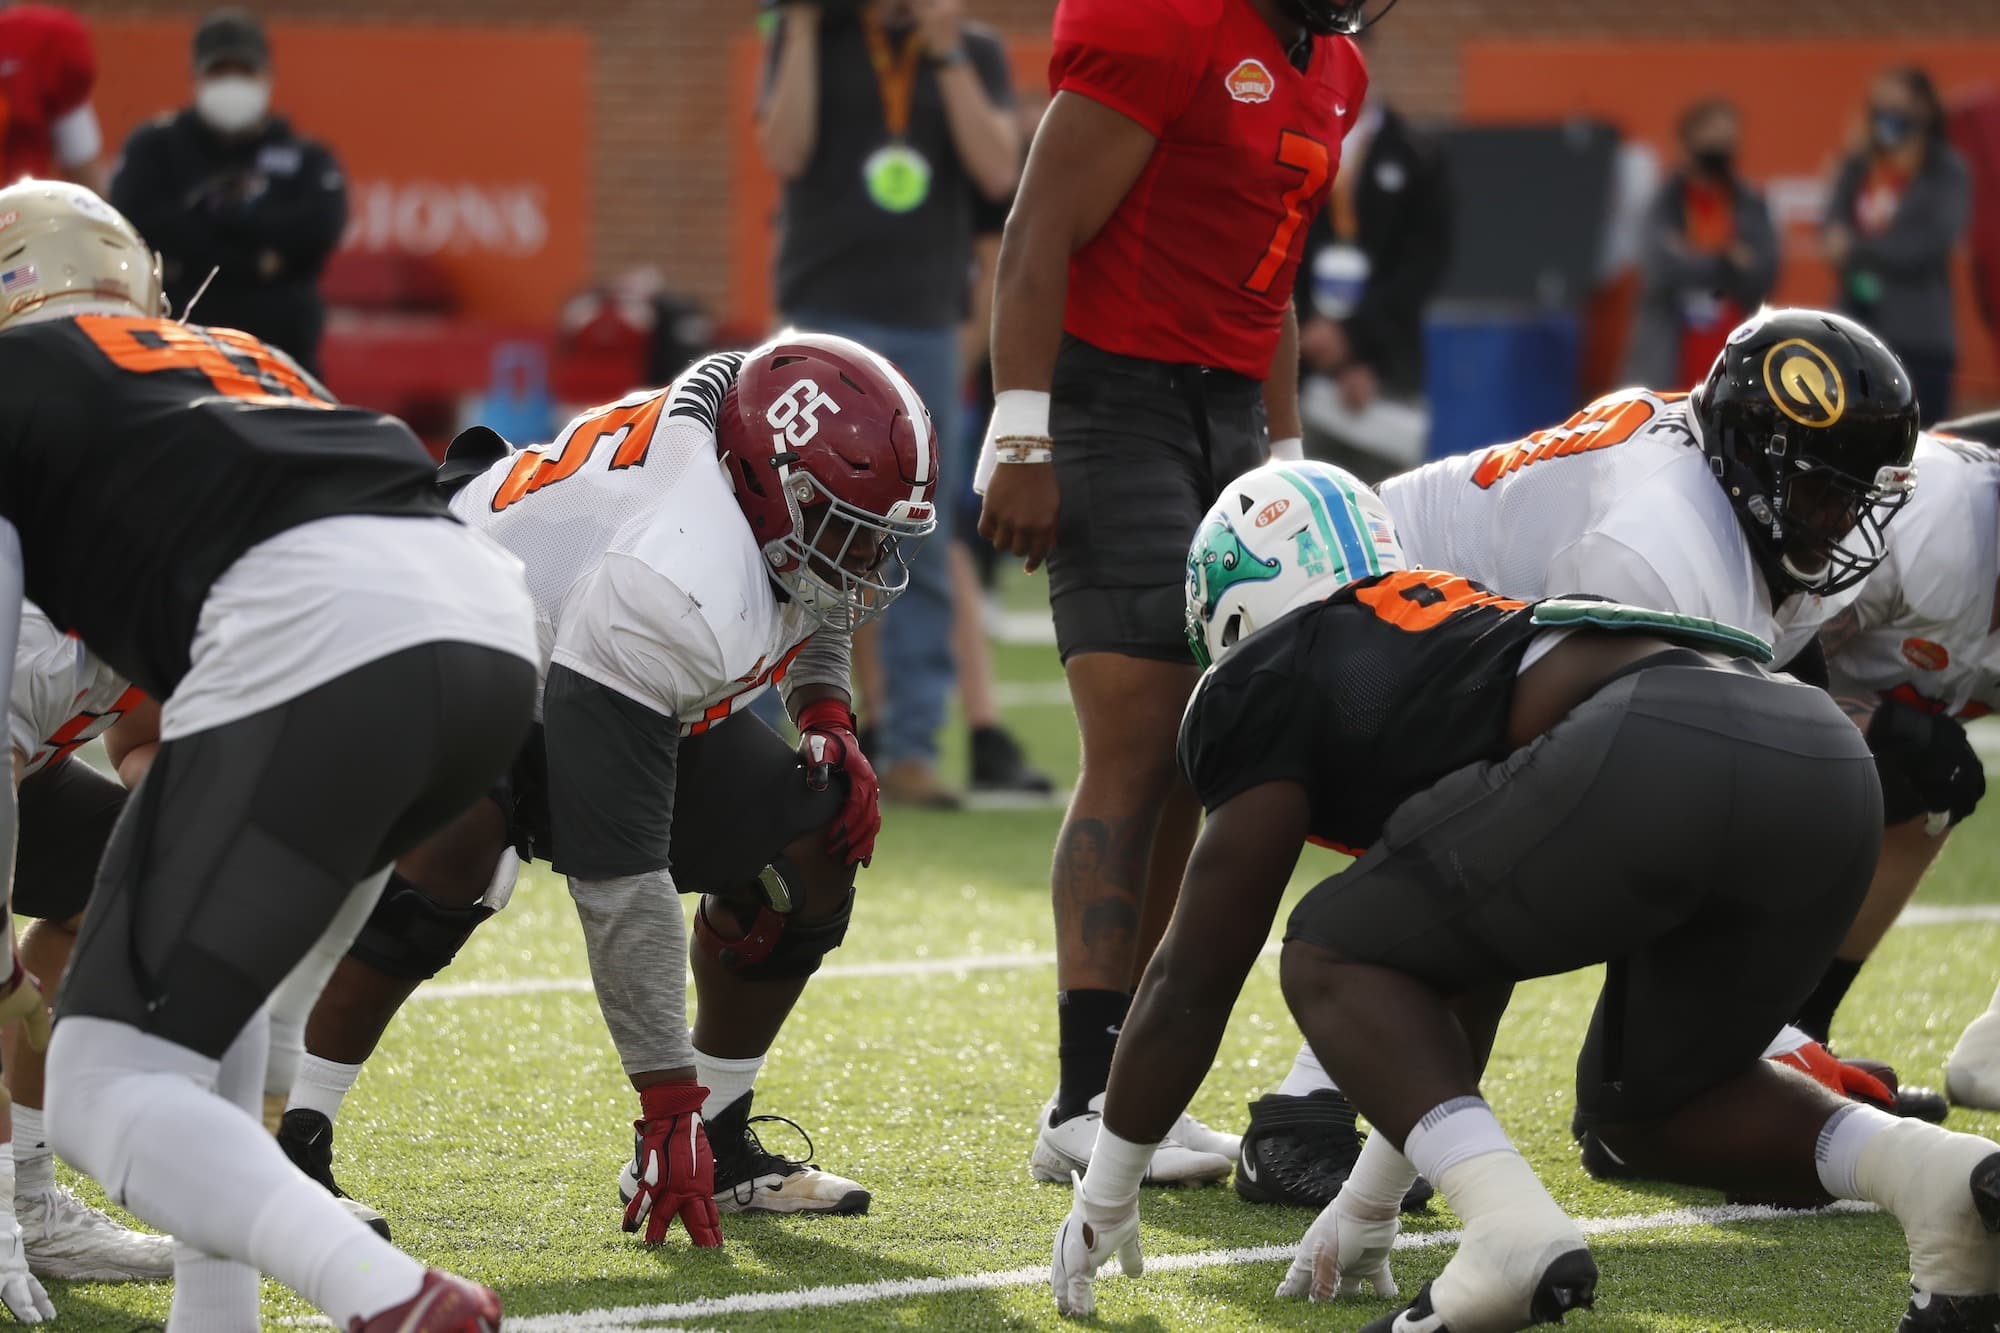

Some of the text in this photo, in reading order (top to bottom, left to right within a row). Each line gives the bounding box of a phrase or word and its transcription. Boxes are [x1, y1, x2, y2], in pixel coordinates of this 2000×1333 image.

[346, 182, 548, 255] IONS
[1241, 128, 1329, 295] 7
[767, 379, 842, 447] 65
[492, 385, 671, 512] 5
[1258, 500, 1287, 525] 678
[1772, 497, 1783, 540] Riell
